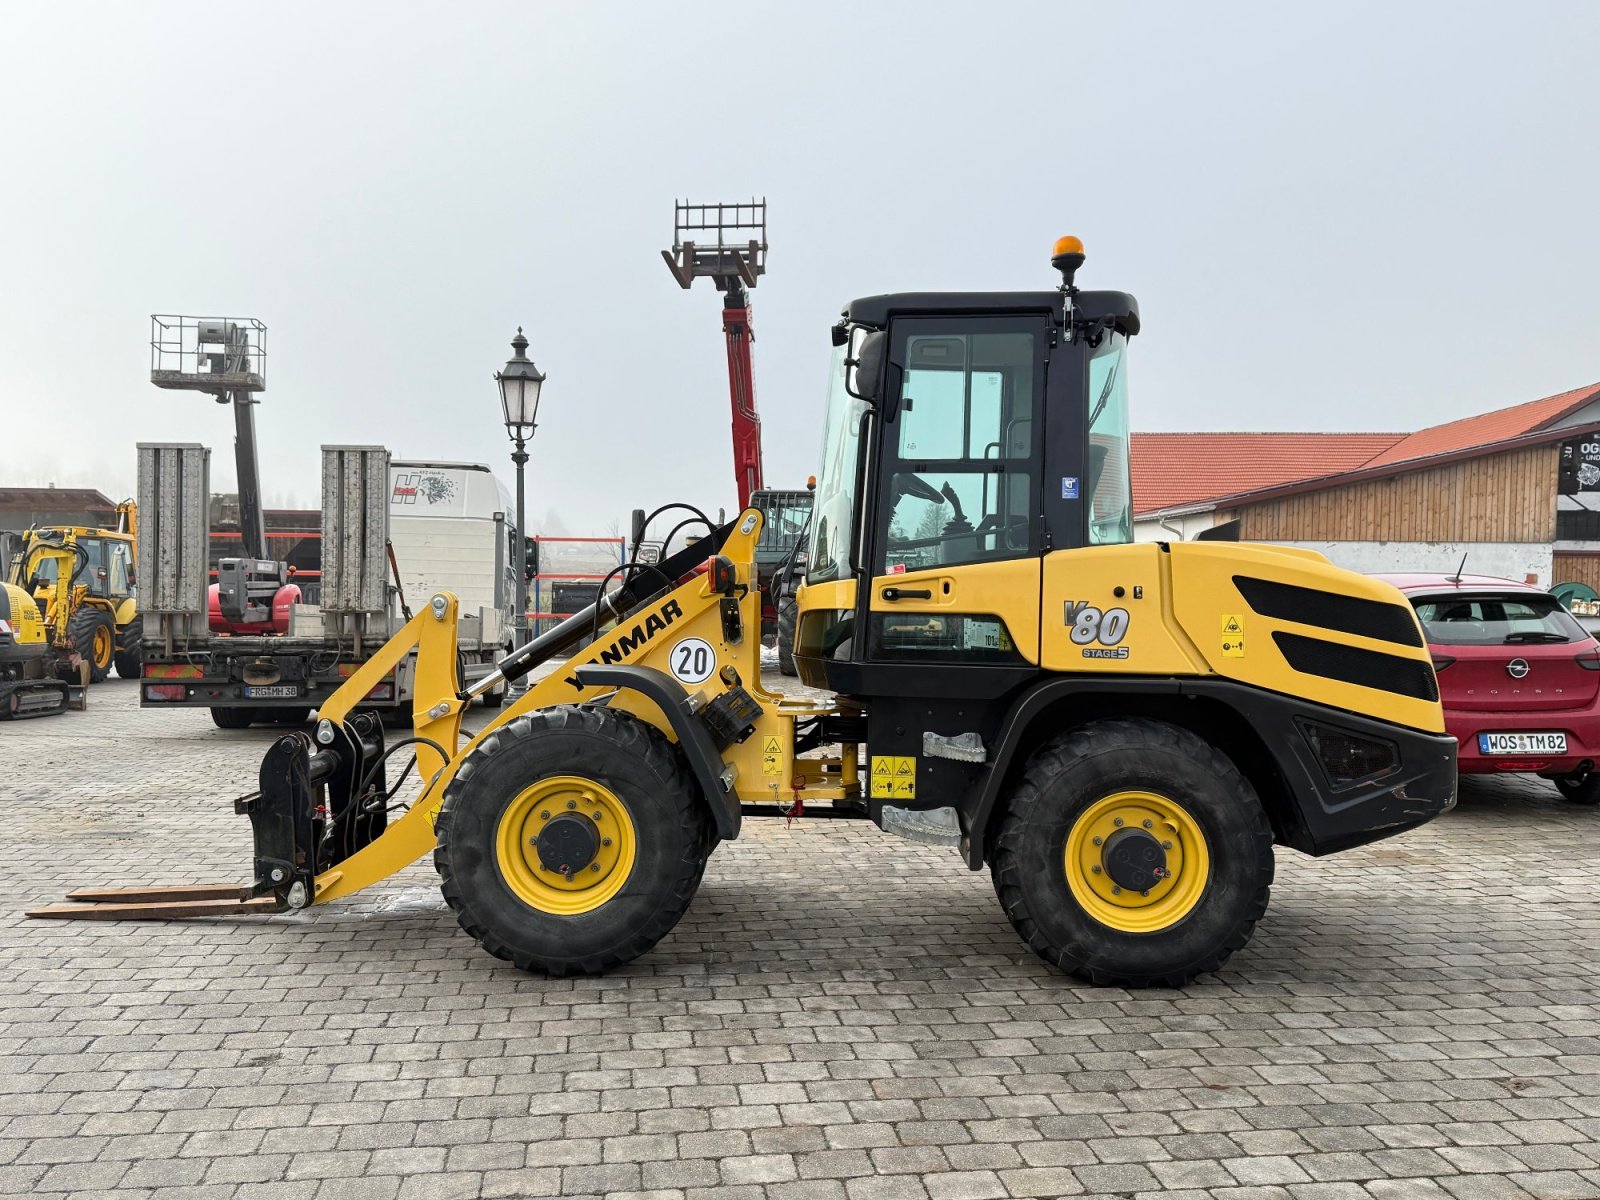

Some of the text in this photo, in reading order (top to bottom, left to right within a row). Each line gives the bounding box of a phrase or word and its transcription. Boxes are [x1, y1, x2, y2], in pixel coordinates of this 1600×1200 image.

[1581, 443, 1600, 454] OG
[564, 599, 683, 692] YNMAR
[678, 646, 708, 676] 20
[1489, 735, 1518, 750] WOS
